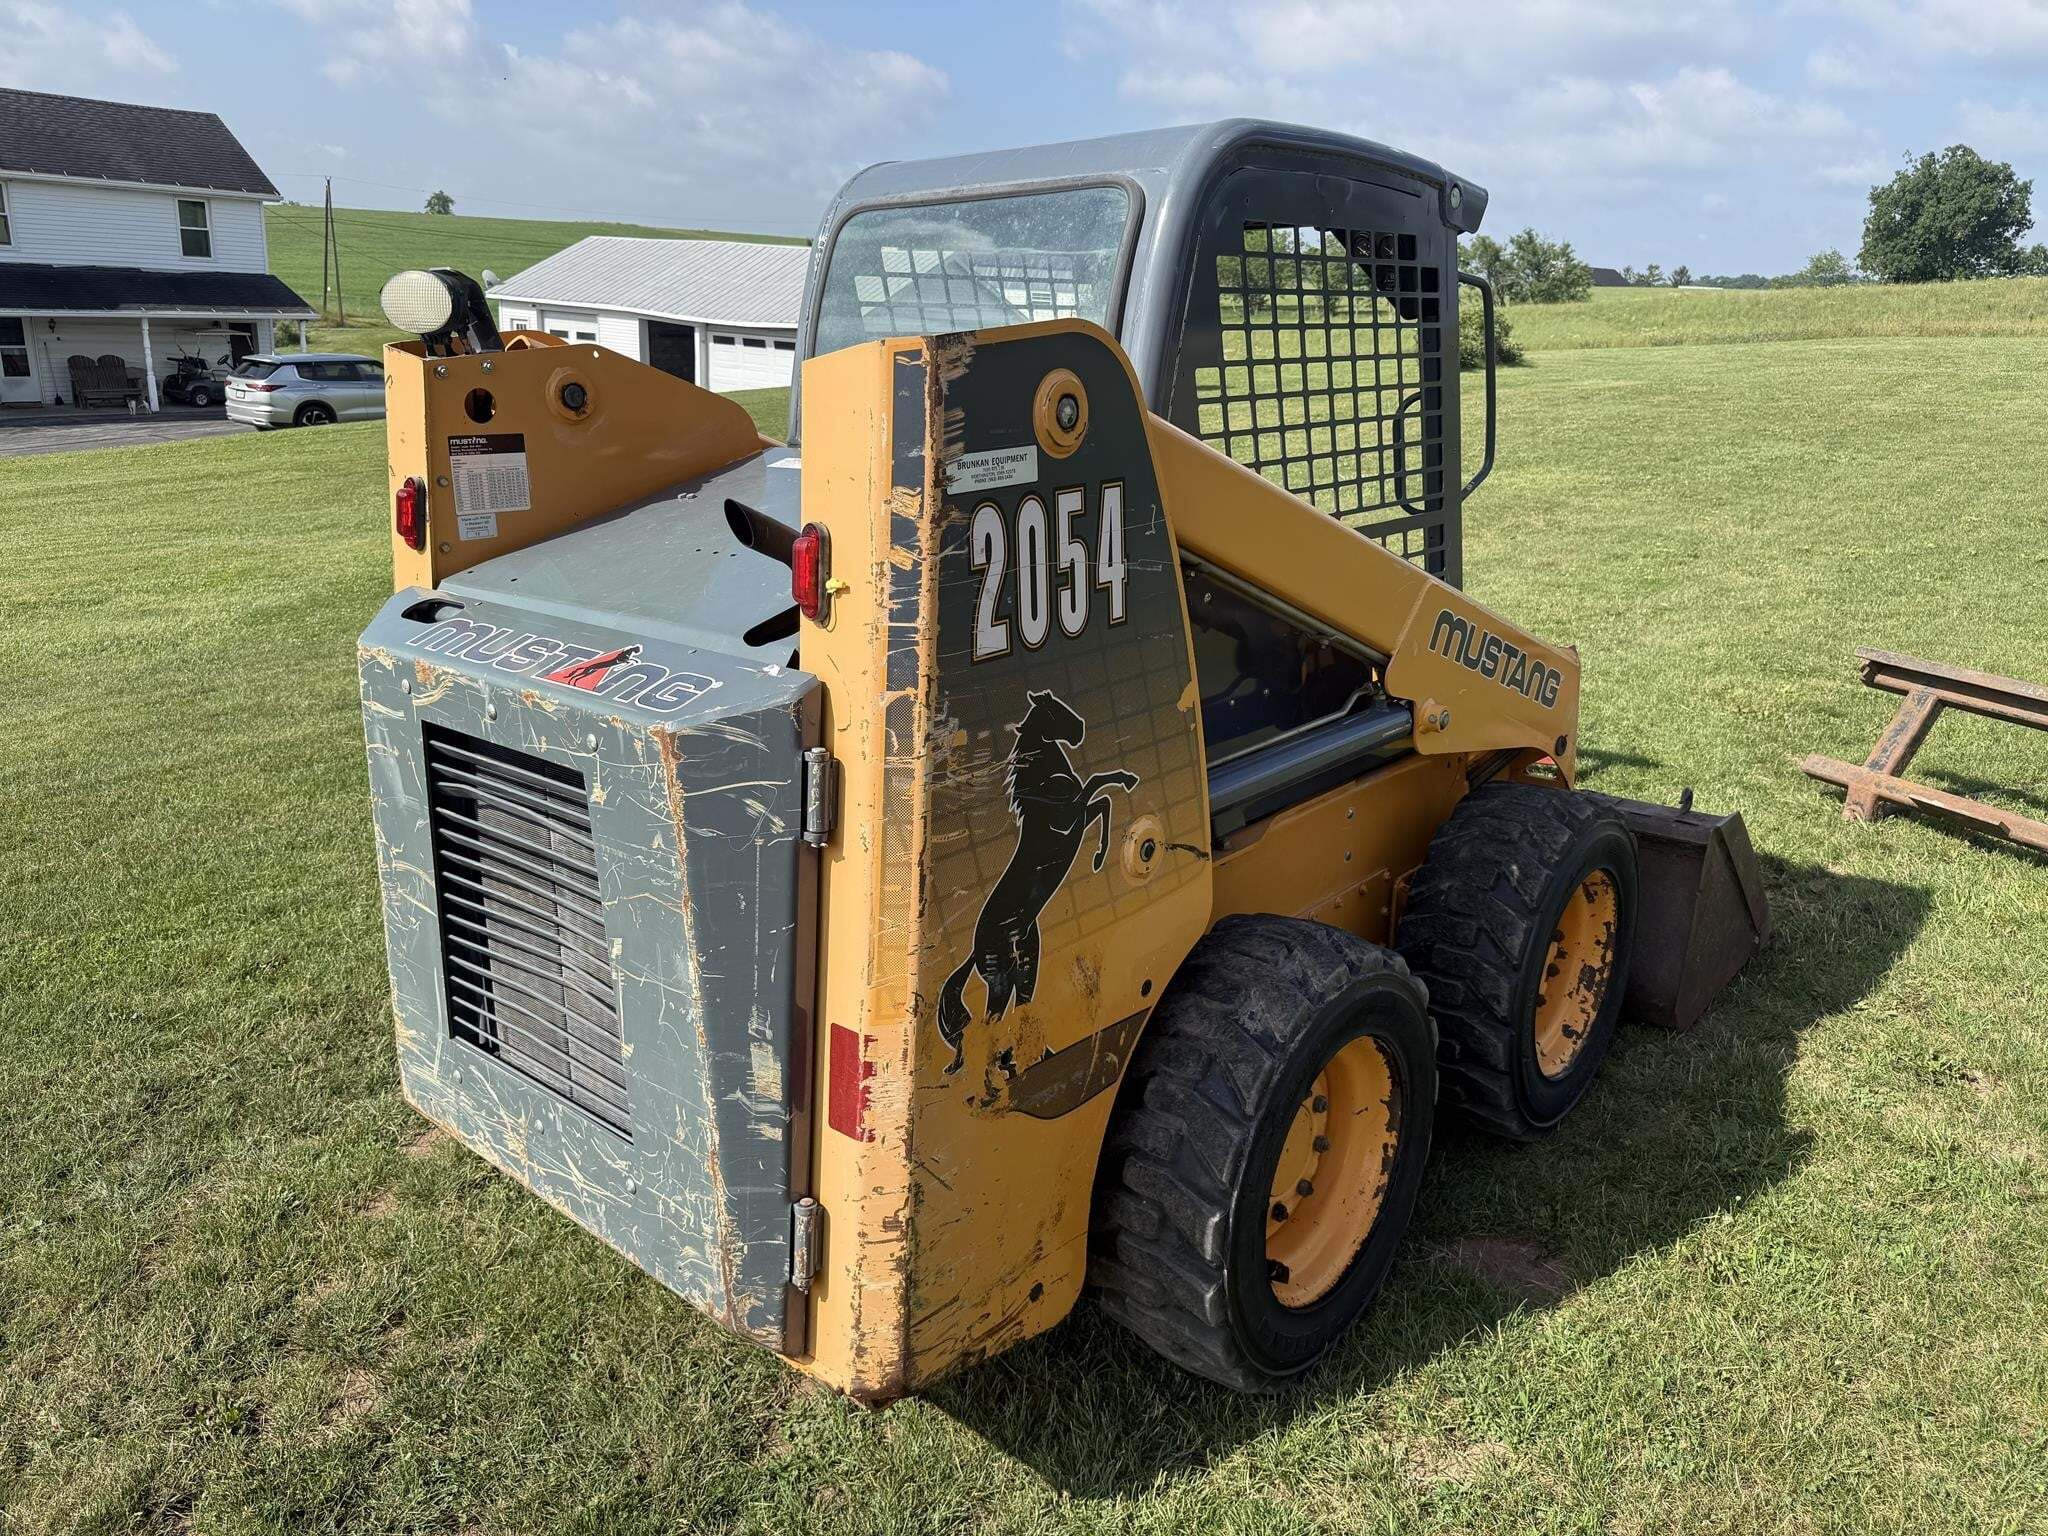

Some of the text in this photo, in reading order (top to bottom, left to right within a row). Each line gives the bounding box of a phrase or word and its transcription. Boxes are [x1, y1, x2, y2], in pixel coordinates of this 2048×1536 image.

[957, 459, 990, 471] BRUNKAN
[992, 454, 1028, 466] EQUIPMENT
[970, 482, 1127, 661] 2054
[406, 617, 718, 712] MUSTANG
[1428, 608, 1562, 709] MUSTANG
